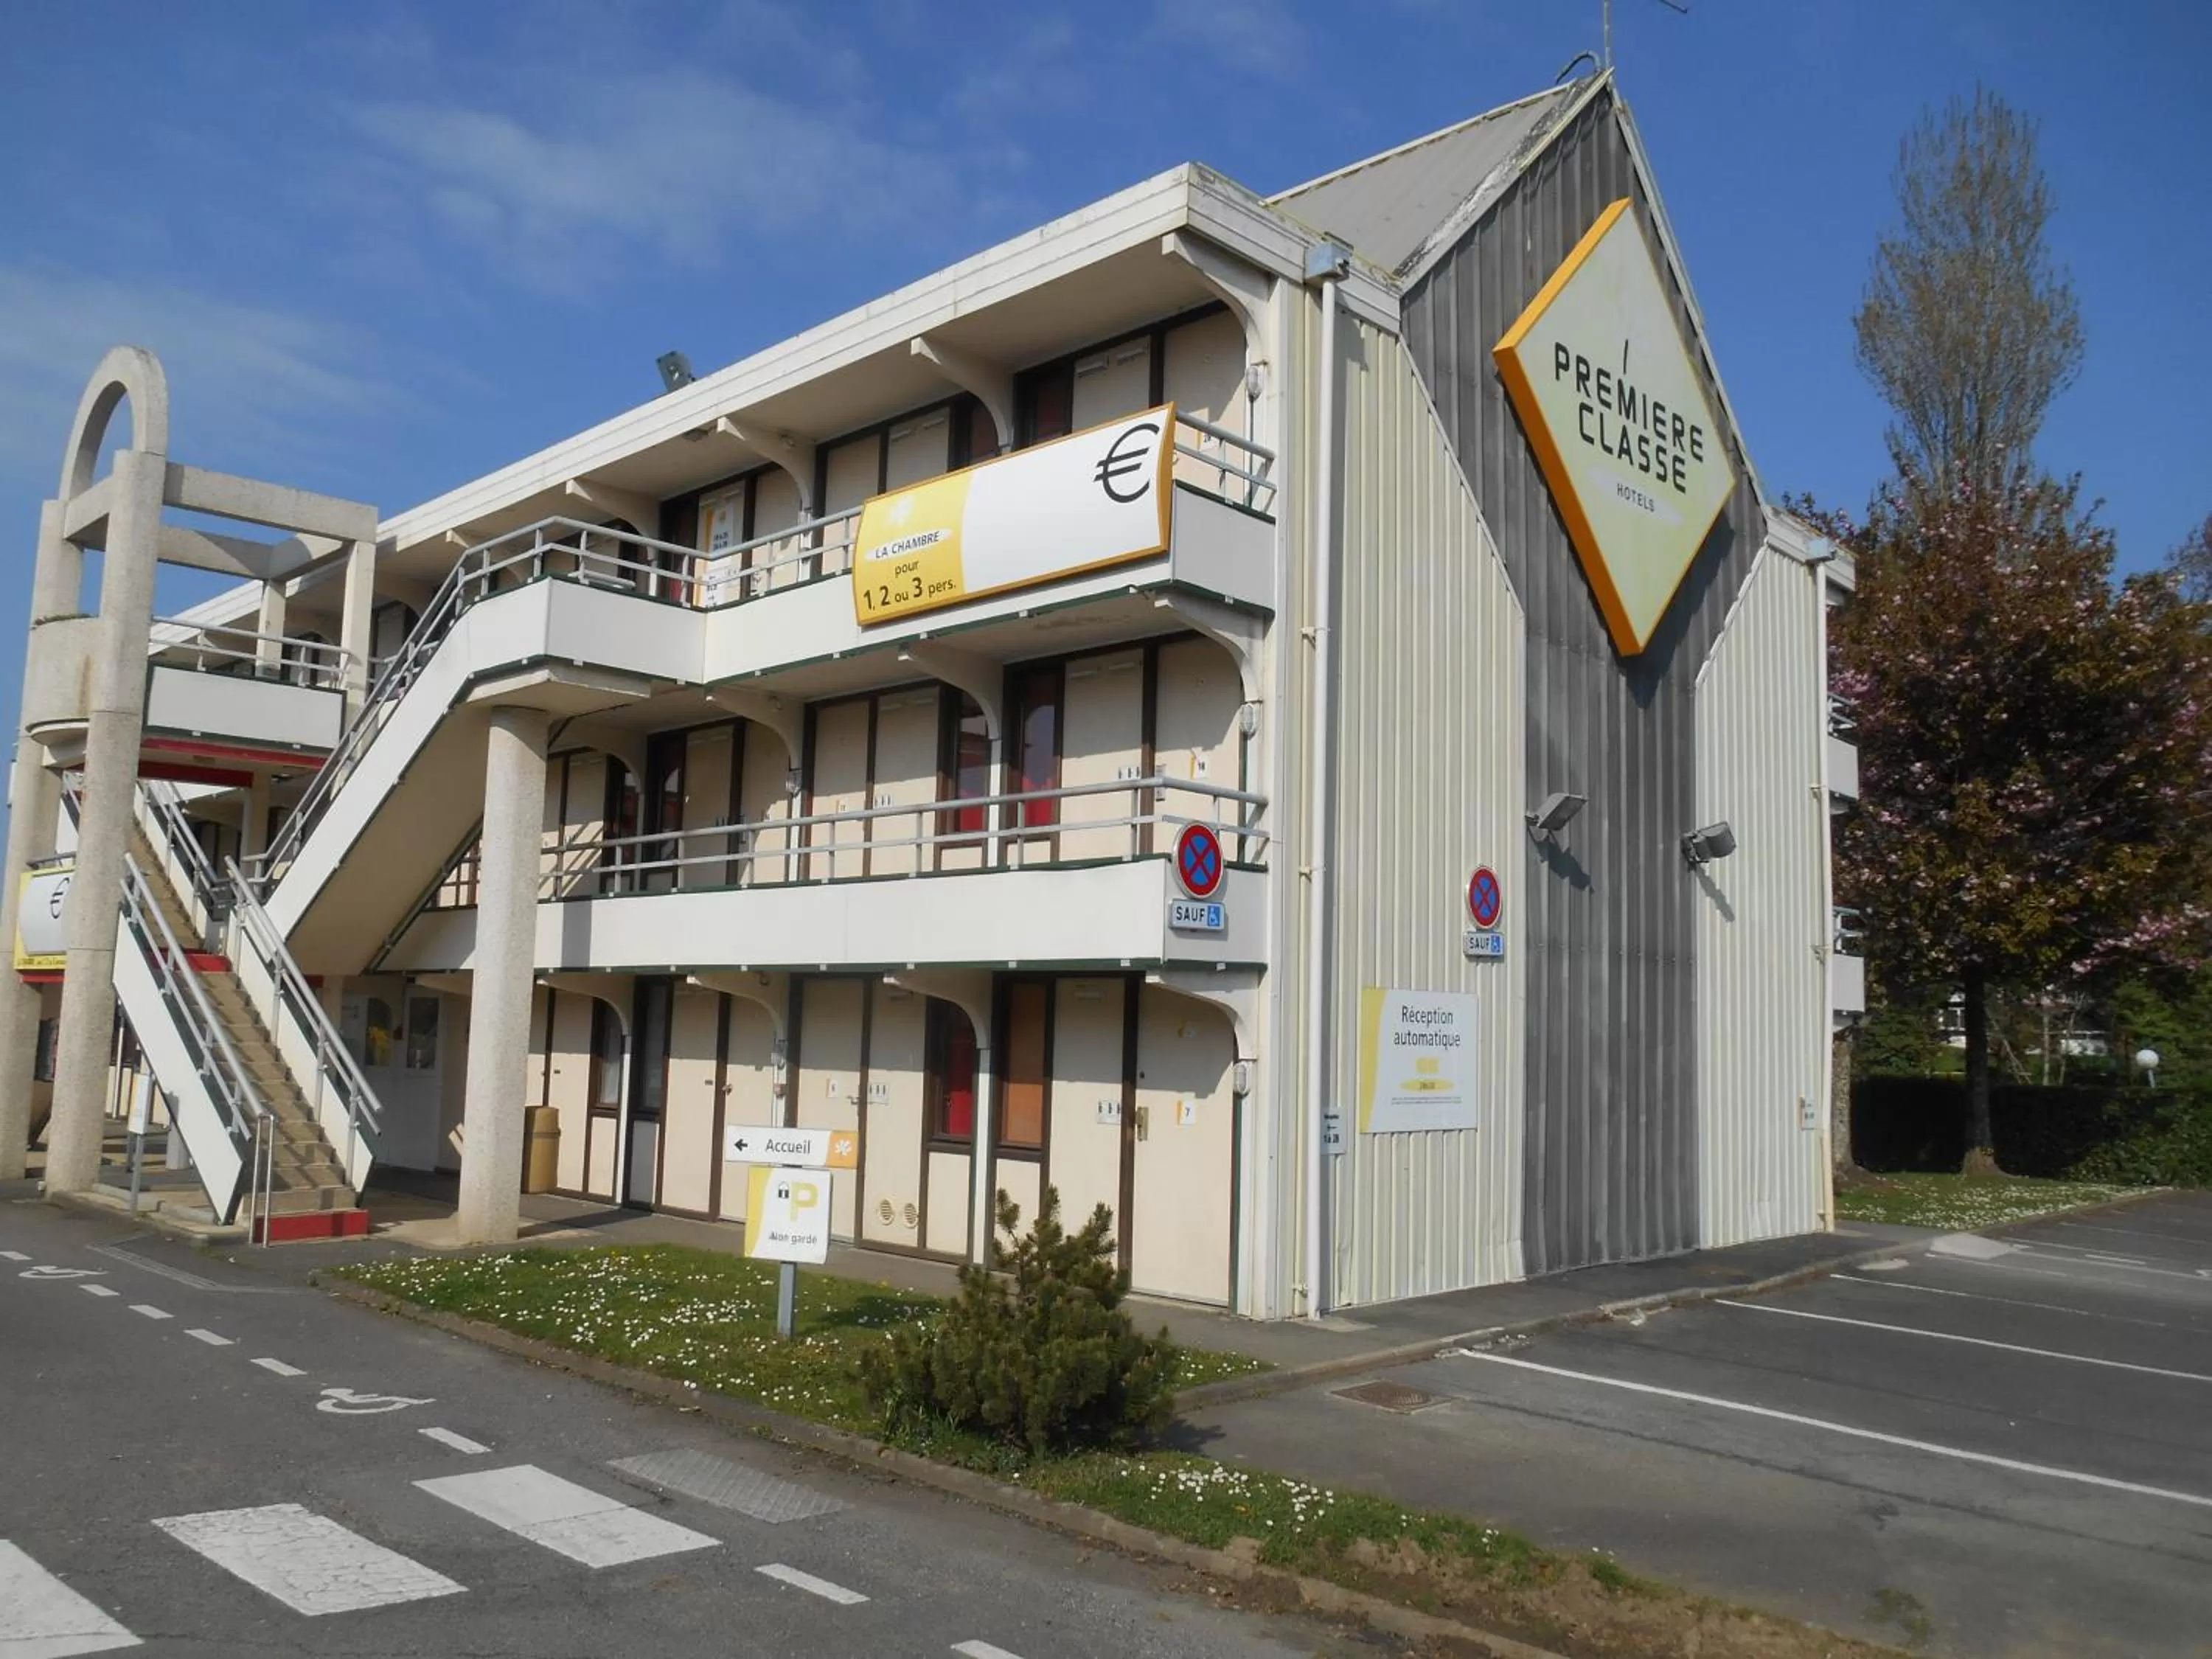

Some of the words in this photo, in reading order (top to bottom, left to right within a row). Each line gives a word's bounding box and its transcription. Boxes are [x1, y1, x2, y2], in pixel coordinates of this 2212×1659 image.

[1554, 341, 1703, 462] PREMIERE
[1578, 402, 1686, 494] CLASSE
[1616, 482, 1655, 512] HOTELS
[875, 546, 888, 558] LA
[891, 530, 939, 554] CHAMBRE
[894, 560, 919, 578] pour
[880, 585, 891, 607] 2
[894, 593, 908, 602] ou
[911, 577, 922, 598] 3
[928, 579, 956, 597] pers.
[1176, 905, 1206, 922] SAUF
[1470, 937, 1490, 950] SAUF
[1402, 1005, 1453, 1029] Réception
[1394, 1029, 1461, 1050] automatique
[766, 1138, 811, 1155] Accueil
